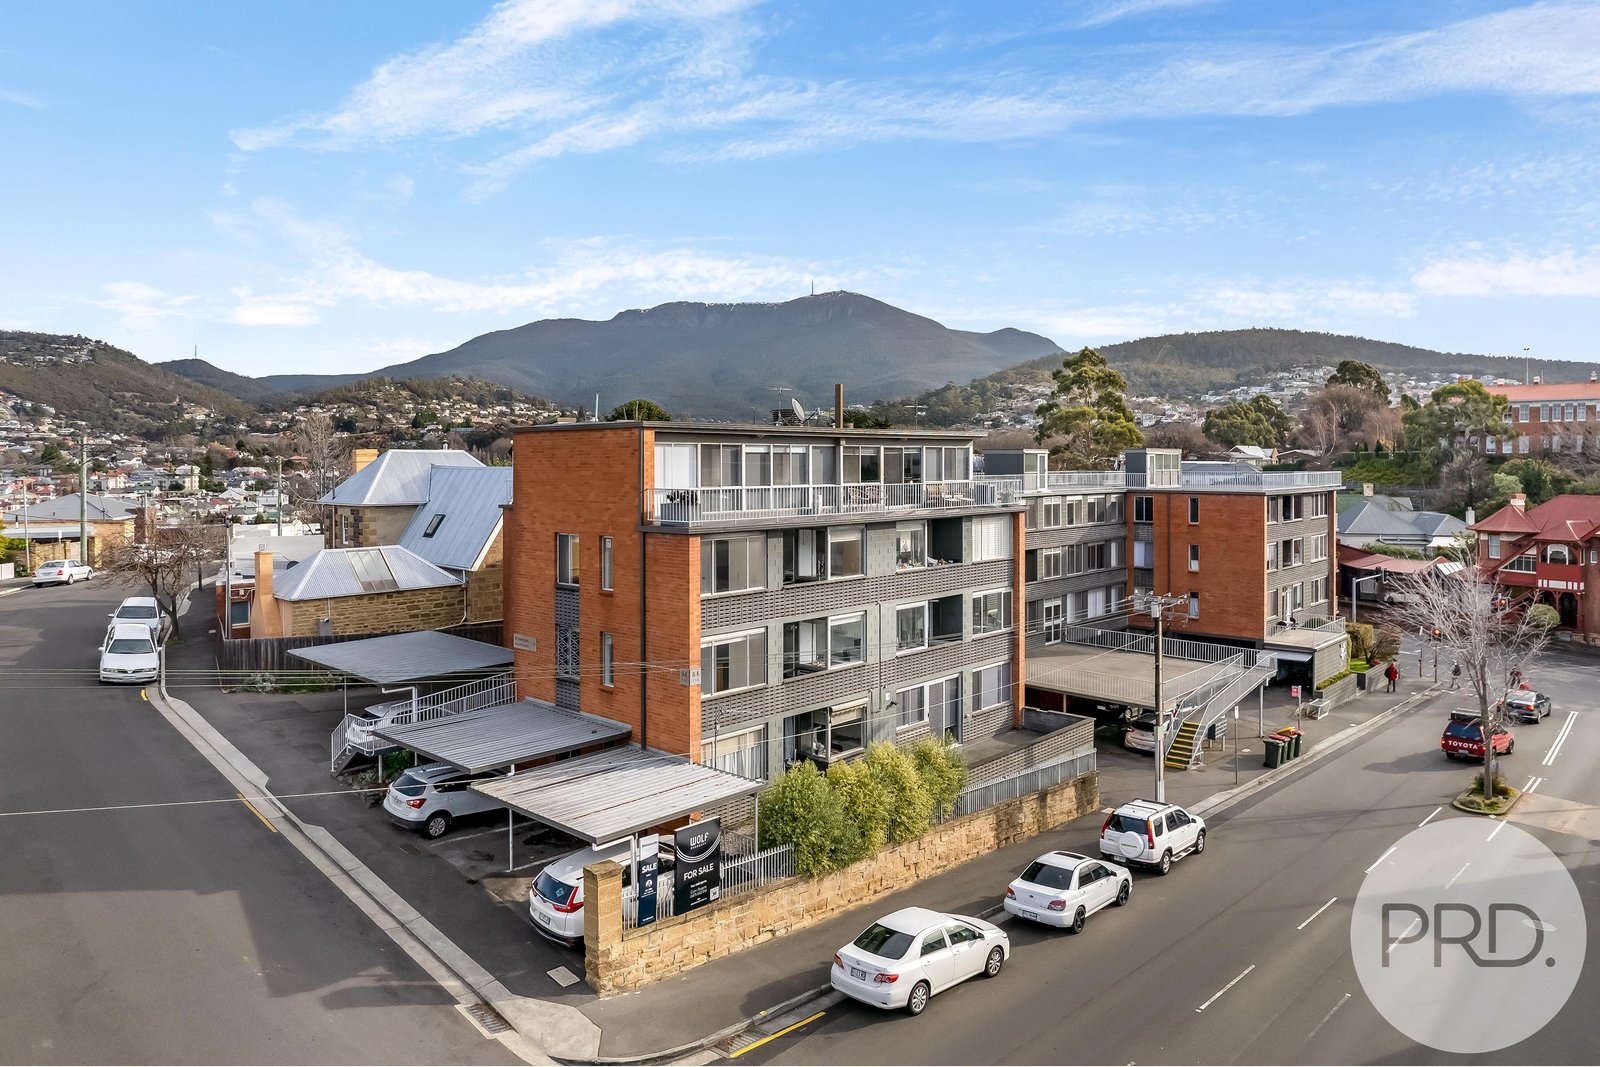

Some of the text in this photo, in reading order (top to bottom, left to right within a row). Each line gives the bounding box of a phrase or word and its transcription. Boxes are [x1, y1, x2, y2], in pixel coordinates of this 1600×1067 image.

[1448, 740, 1478, 750] TOYOTA
[690, 832, 709, 847] WOLF
[641, 863, 657, 874] SALE
[684, 862, 714, 881] FOR SALE
